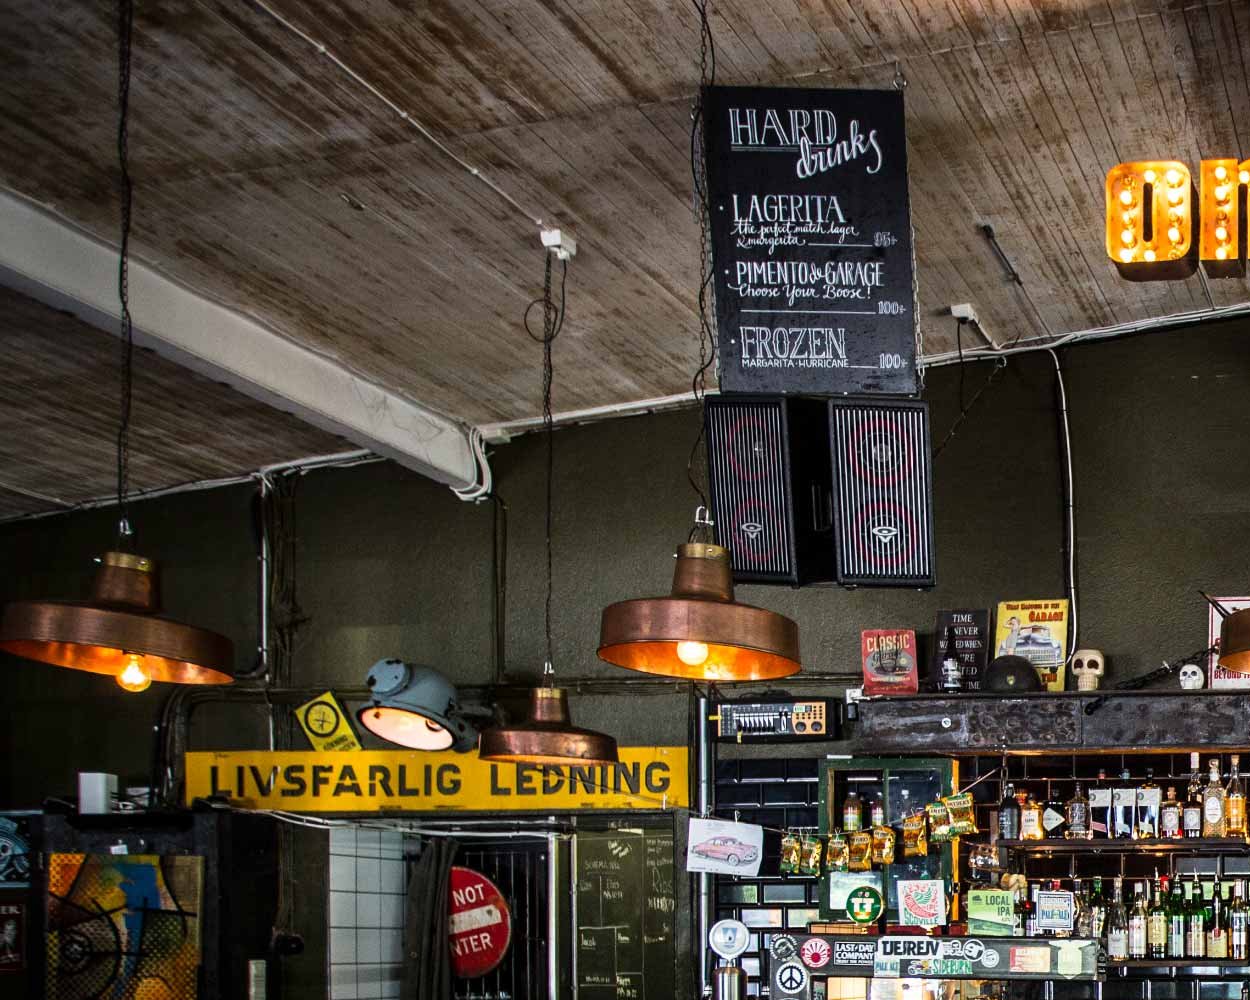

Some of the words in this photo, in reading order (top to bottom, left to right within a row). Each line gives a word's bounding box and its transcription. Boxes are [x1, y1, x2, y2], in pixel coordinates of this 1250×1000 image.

[729, 108, 837, 145] HARD
[796, 120, 883, 178] drinks
[733, 194, 847, 223] LAGERITA
[828, 220, 859, 243] lager
[736, 261, 807, 286] PIMENTO
[825, 261, 885, 287] GARAGE
[728, 283, 780, 298] Choose
[784, 283, 820, 306] Your
[739, 326, 846, 359] FROZEN
[952, 614, 973, 623] TIME
[954, 626, 979, 635] NEVER
[866, 634, 910, 652] CLASSIC
[210, 764, 462, 798] LIVSFARLIG
[490, 761, 671, 795] LEDNING
[452, 883, 485, 907] NOT
[985, 895, 1012, 905] LOCAL
[997, 907, 1011, 917] IPA
[451, 932, 493, 957] NTER
[836, 943, 856, 952] LAST
[858, 943, 875, 952] DAY
[836, 952, 875, 960] COMPANY
